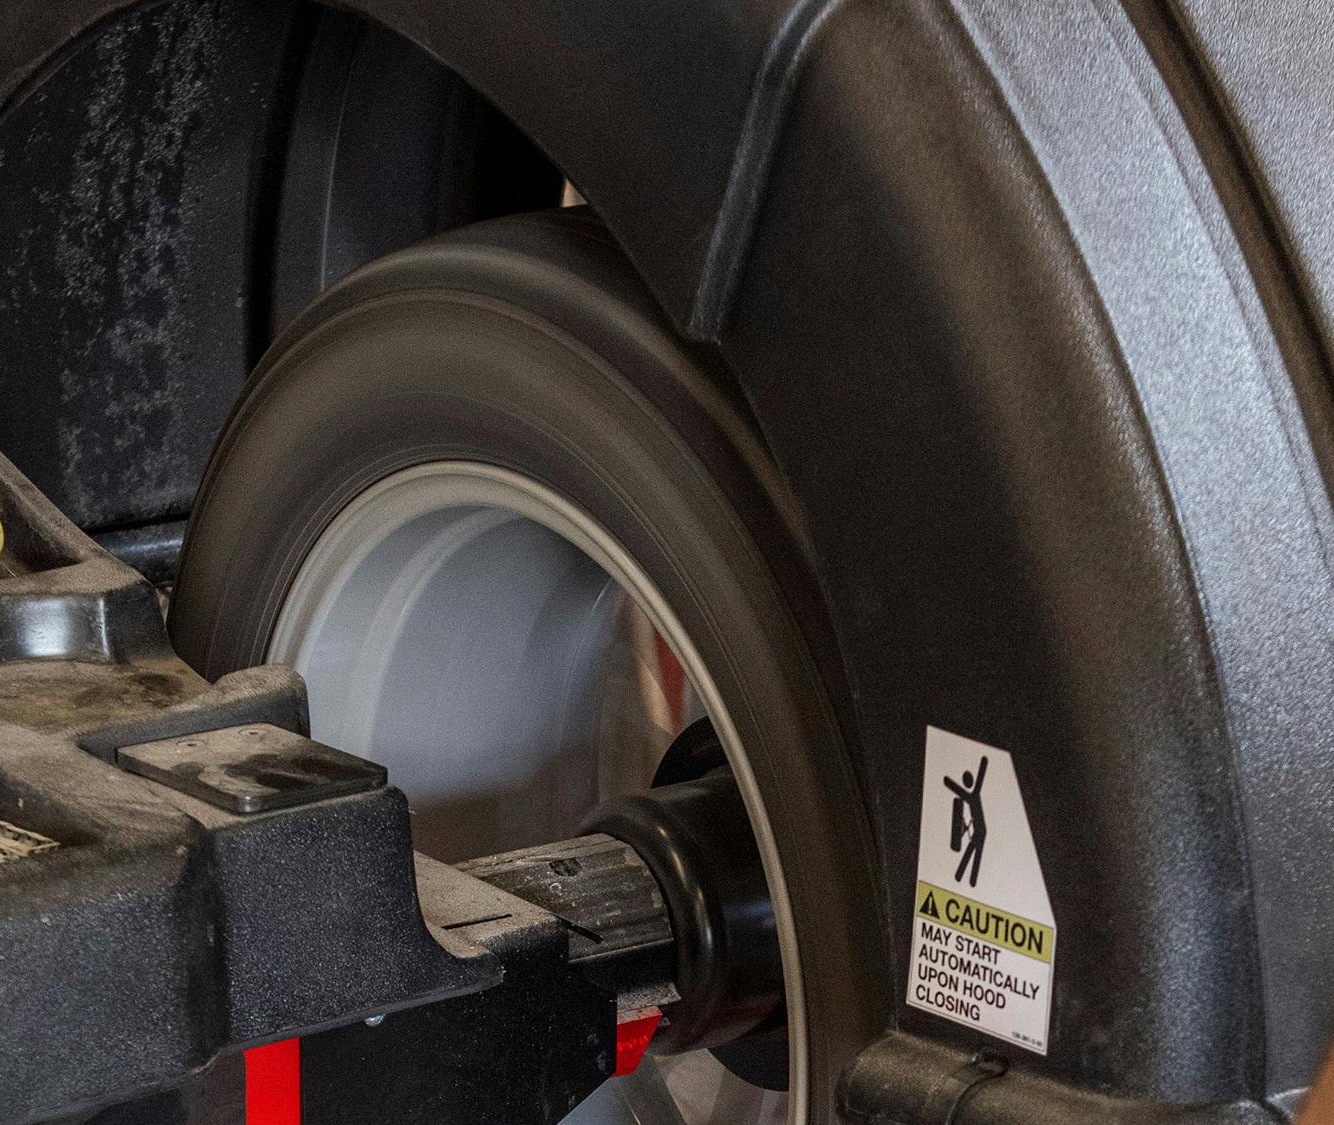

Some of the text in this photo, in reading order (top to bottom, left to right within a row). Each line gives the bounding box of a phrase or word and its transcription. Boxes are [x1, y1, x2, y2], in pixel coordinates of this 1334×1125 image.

[921, 921, 1001, 965] MAY START
[945, 898, 1044, 955] CAUTION
[917, 962, 1007, 1009] UPON HOOD
[918, 943, 1040, 1001] AUTOMATICALLY
[916, 983, 981, 1022] CLOSING
